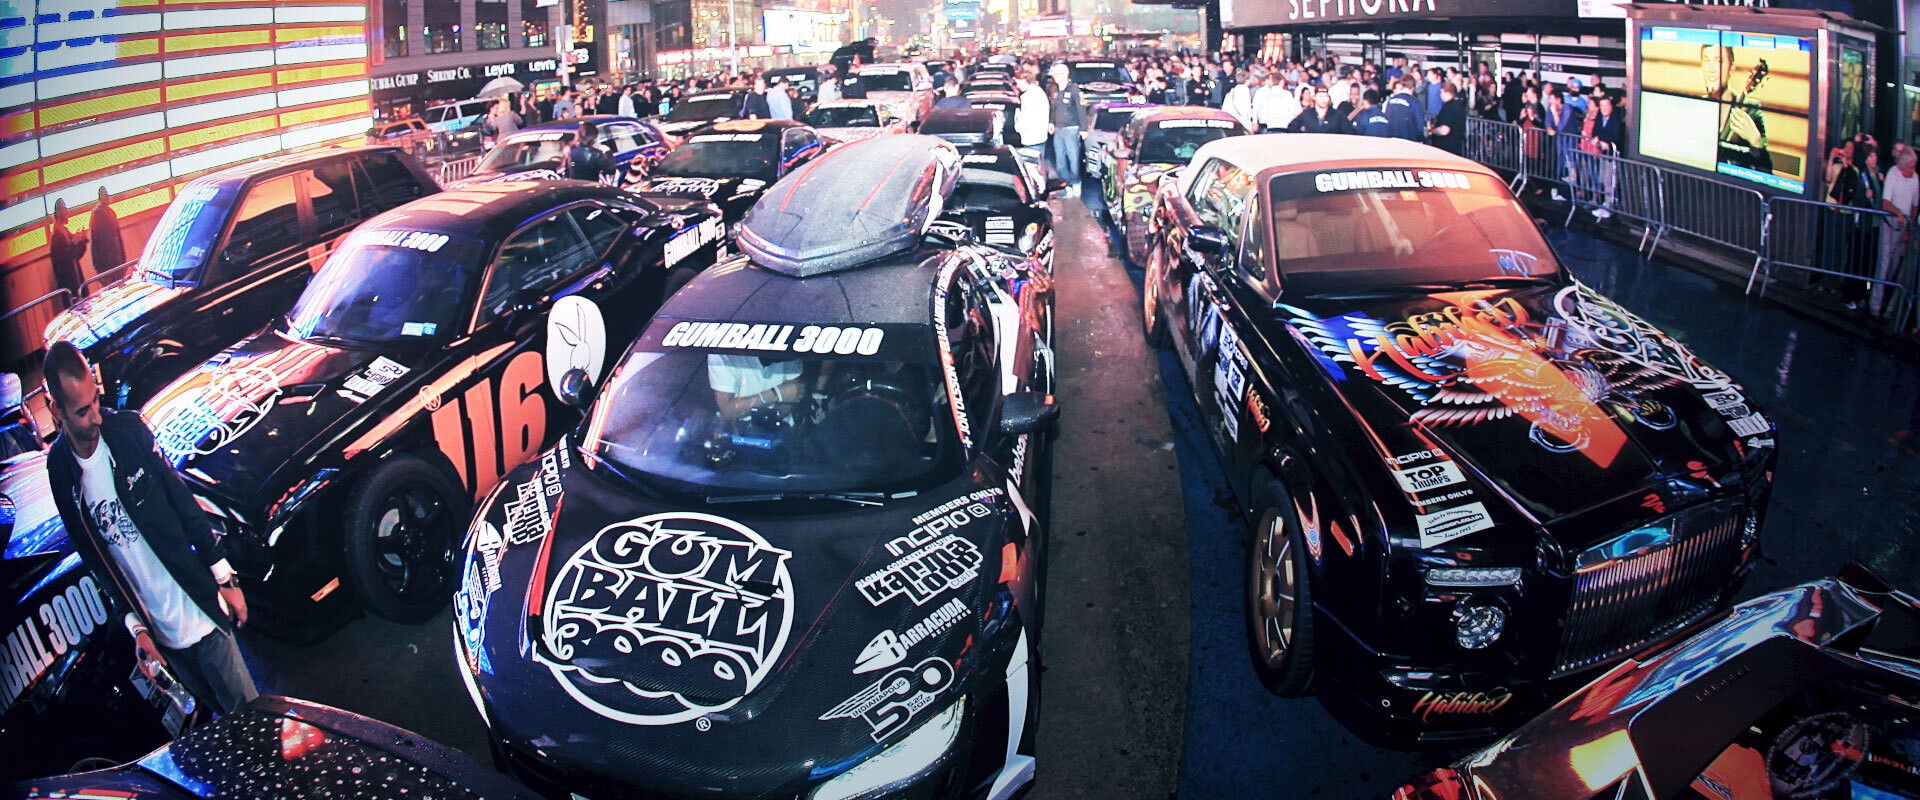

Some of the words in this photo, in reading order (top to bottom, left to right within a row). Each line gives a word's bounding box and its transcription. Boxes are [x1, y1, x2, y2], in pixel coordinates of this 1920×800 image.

[396, 73, 419, 87] GUMP
[1314, 170, 1420, 193] GUMBALL
[1418, 170, 1471, 190] 3000
[400, 230, 450, 253] 3000
[661, 320, 795, 351] GUMBALL
[792, 325, 885, 356] 3000
[431, 350, 547, 501] 116
[1404, 465, 1446, 483] TOP
[1410, 474, 1452, 490] TRUMPS
[911, 495, 970, 526] MEMBERS
[884, 509, 971, 557] INCIPIO
[591, 520, 794, 592] GUM
[39, 575, 108, 655] 3000
[556, 558, 784, 668] BALL
[862, 596, 968, 669] BARRACUDA
[542, 611, 753, 711] 3000
[852, 680, 906, 717] INDIANAPOLIS
[862, 656, 955, 744] 500
